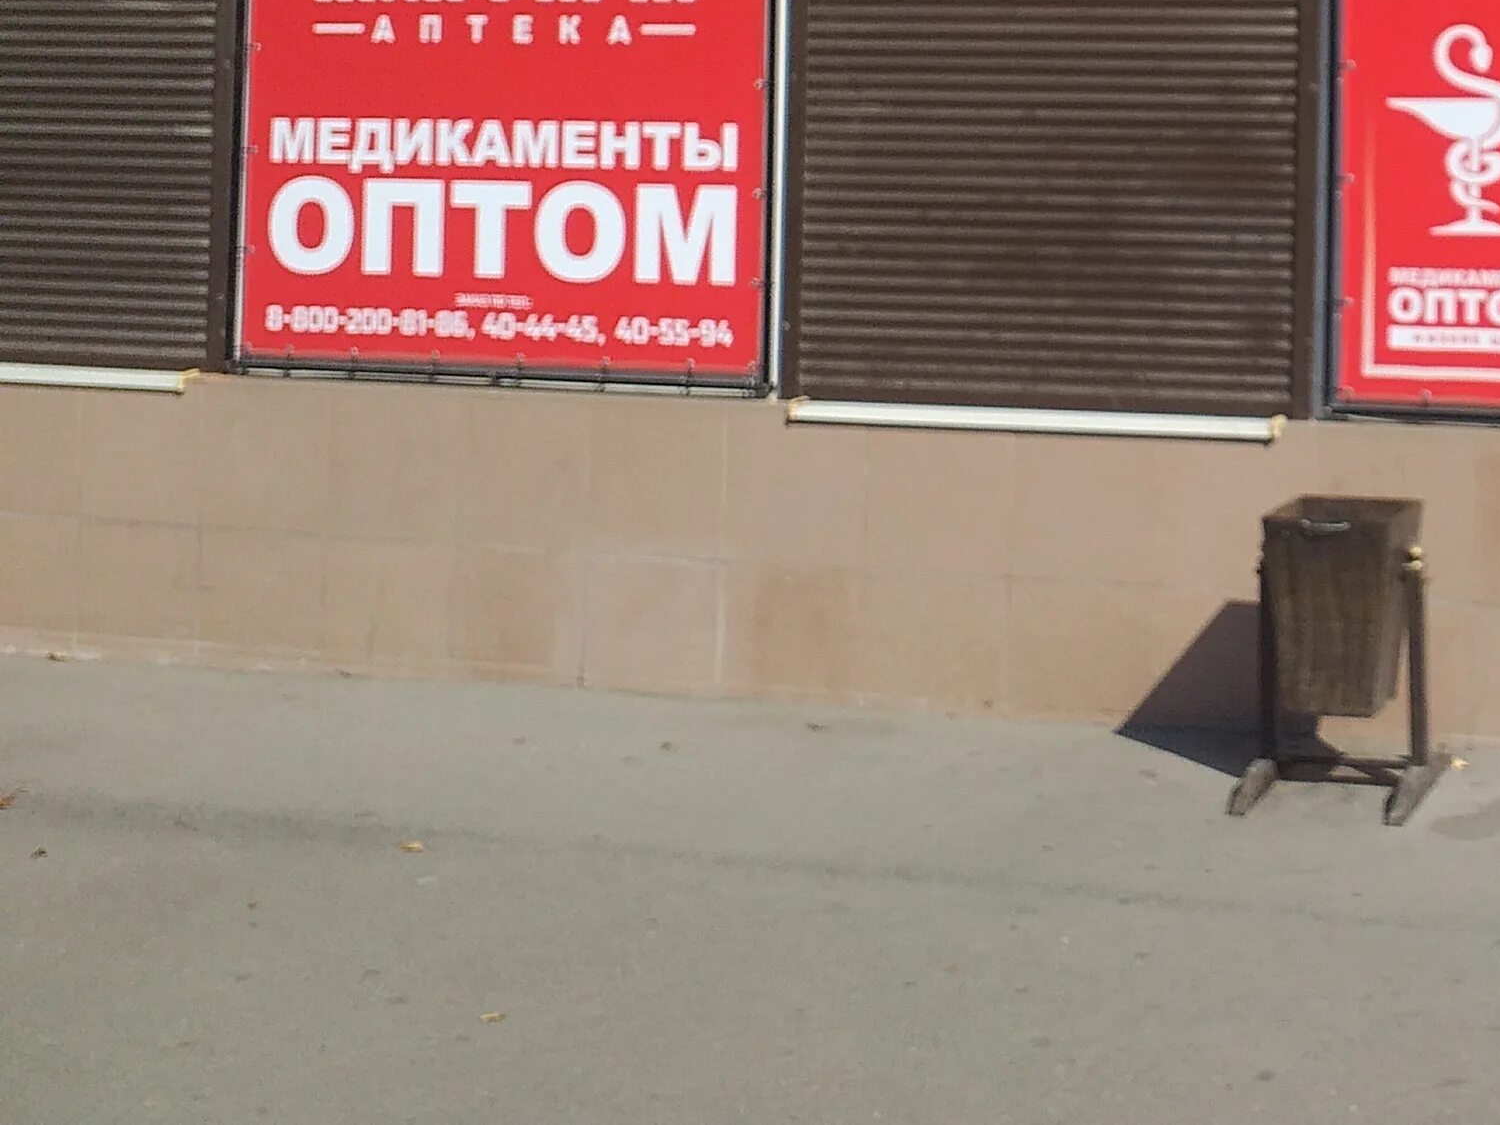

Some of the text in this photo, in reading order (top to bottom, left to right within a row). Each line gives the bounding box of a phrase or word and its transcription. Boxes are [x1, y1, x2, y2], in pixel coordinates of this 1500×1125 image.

[370, 15, 633, 45] АПТЕКА
[269, 117, 739, 172] МЕДИКАМЕНТЫ
[267, 175, 738, 286] ОПТОМ
